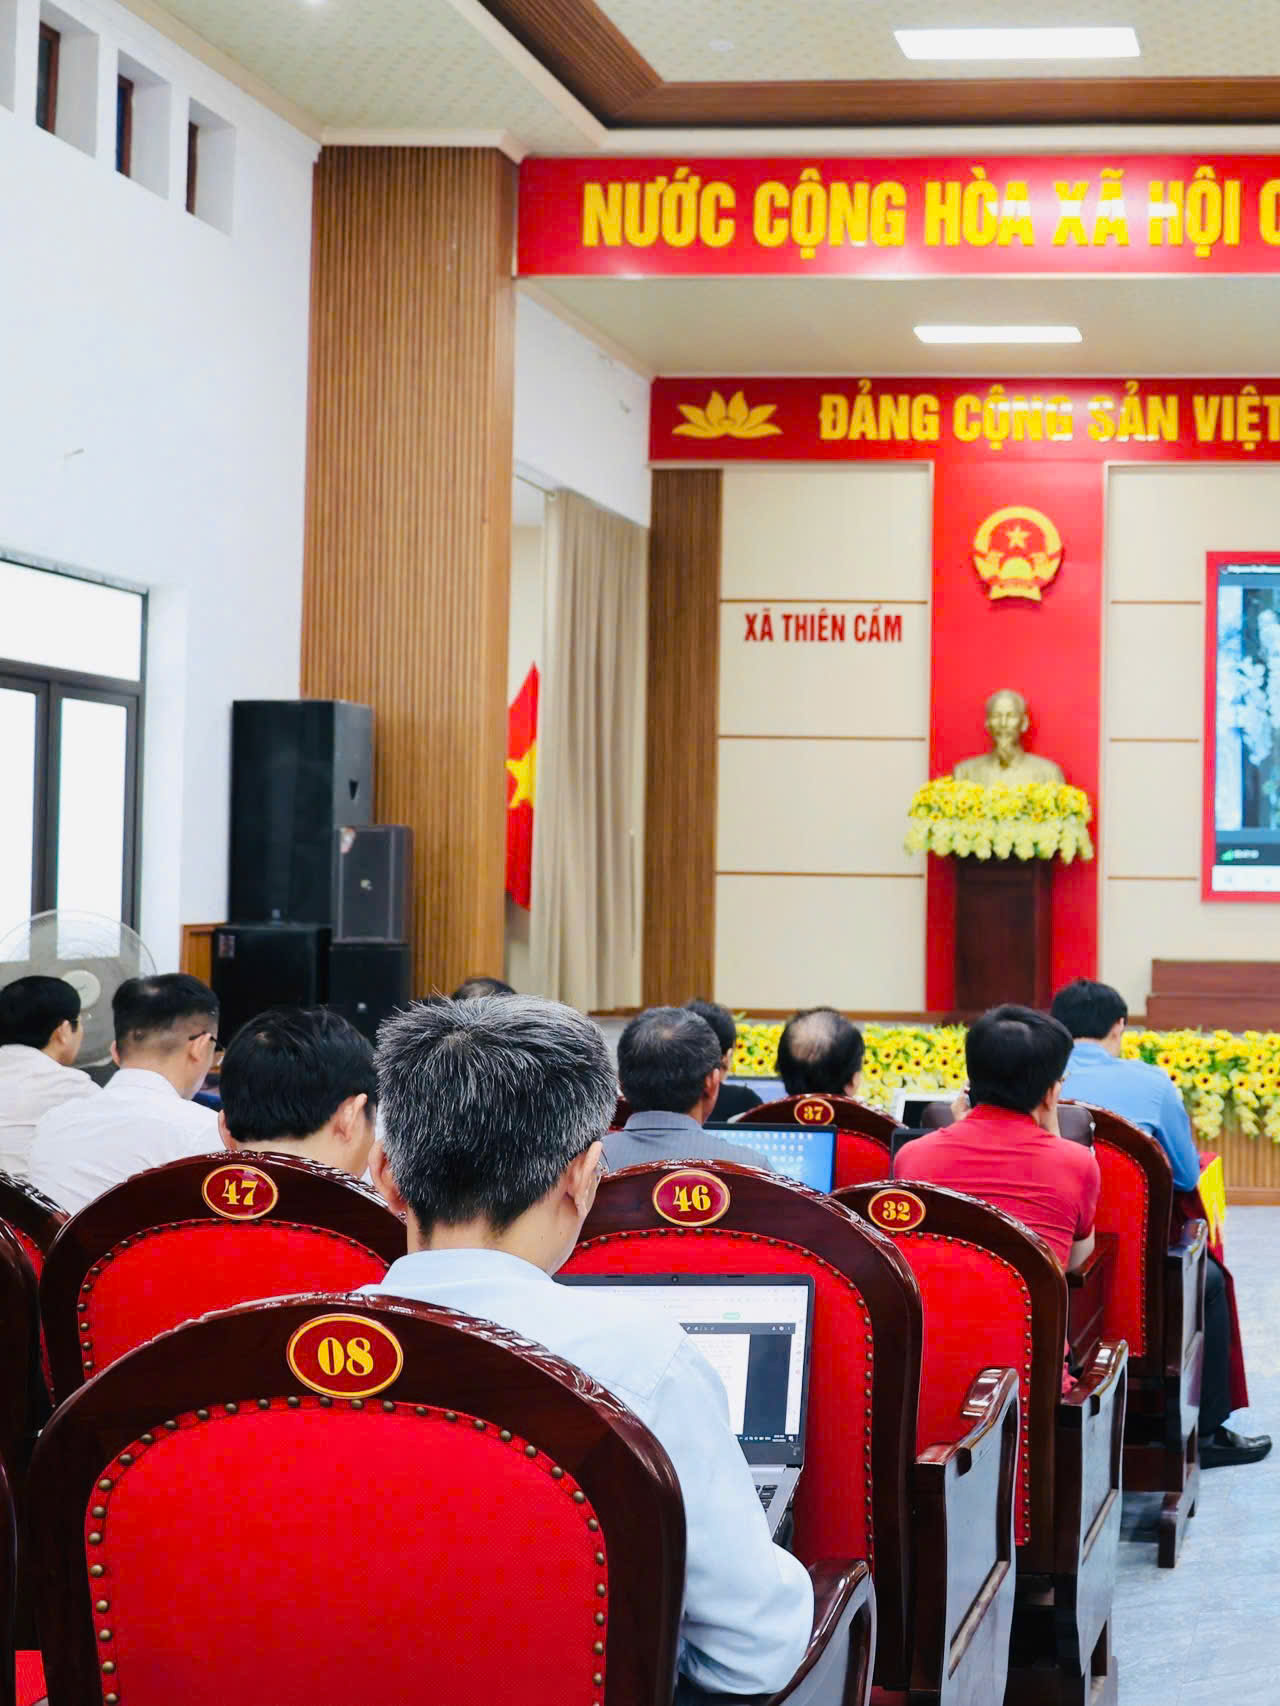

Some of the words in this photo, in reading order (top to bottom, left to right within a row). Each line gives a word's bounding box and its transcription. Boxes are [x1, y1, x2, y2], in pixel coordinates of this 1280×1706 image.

[582, 167, 736, 248] NƯỚC
[753, 168, 908, 260] CỘNG
[923, 167, 1036, 249] HÒA
[1050, 168, 1131, 249] XÃ
[1146, 165, 1241, 260] HỘI
[818, 379, 940, 441] ĐẢNG
[953, 385, 1075, 452] CỘNG
[1088, 380, 1179, 443] SẢN
[744, 607, 774, 642] XÃ
[781, 607, 846, 642] THIÊN
[803, 1105, 824, 1121] 37
[221, 1180, 257, 1207] 47
[672, 1184, 711, 1212] 46
[882, 1200, 911, 1221] 32
[317, 1337, 374, 1376] 08
